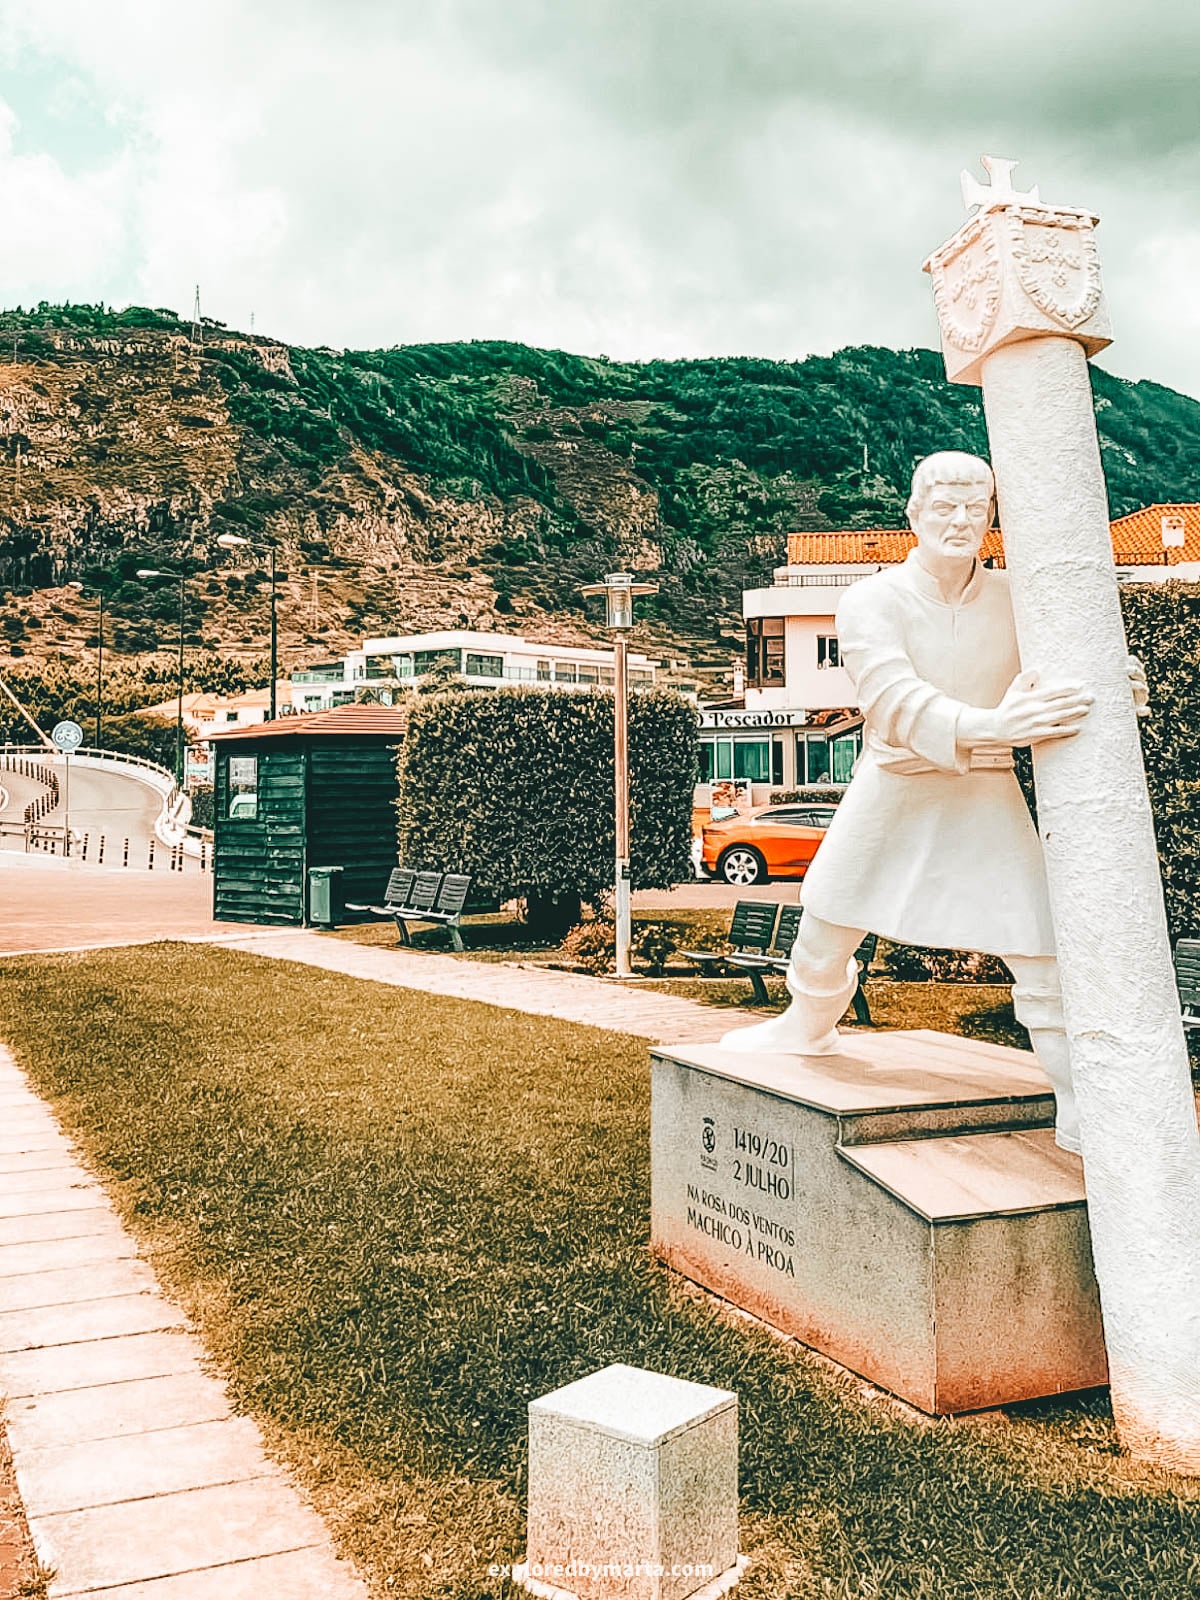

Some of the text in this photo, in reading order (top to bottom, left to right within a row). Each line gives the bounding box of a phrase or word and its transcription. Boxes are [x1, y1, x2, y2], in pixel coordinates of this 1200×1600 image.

[709, 711, 795, 727] Pescador
[734, 1127, 788, 1168] 1419/20
[733, 1160, 742, 1181] 2
[744, 1164, 790, 1200] JULHO
[687, 1184, 795, 1247] NA ROSA DOS VENTOS
[687, 1207, 742, 1250] MACHICO
[758, 1241, 795, 1278] PROA
